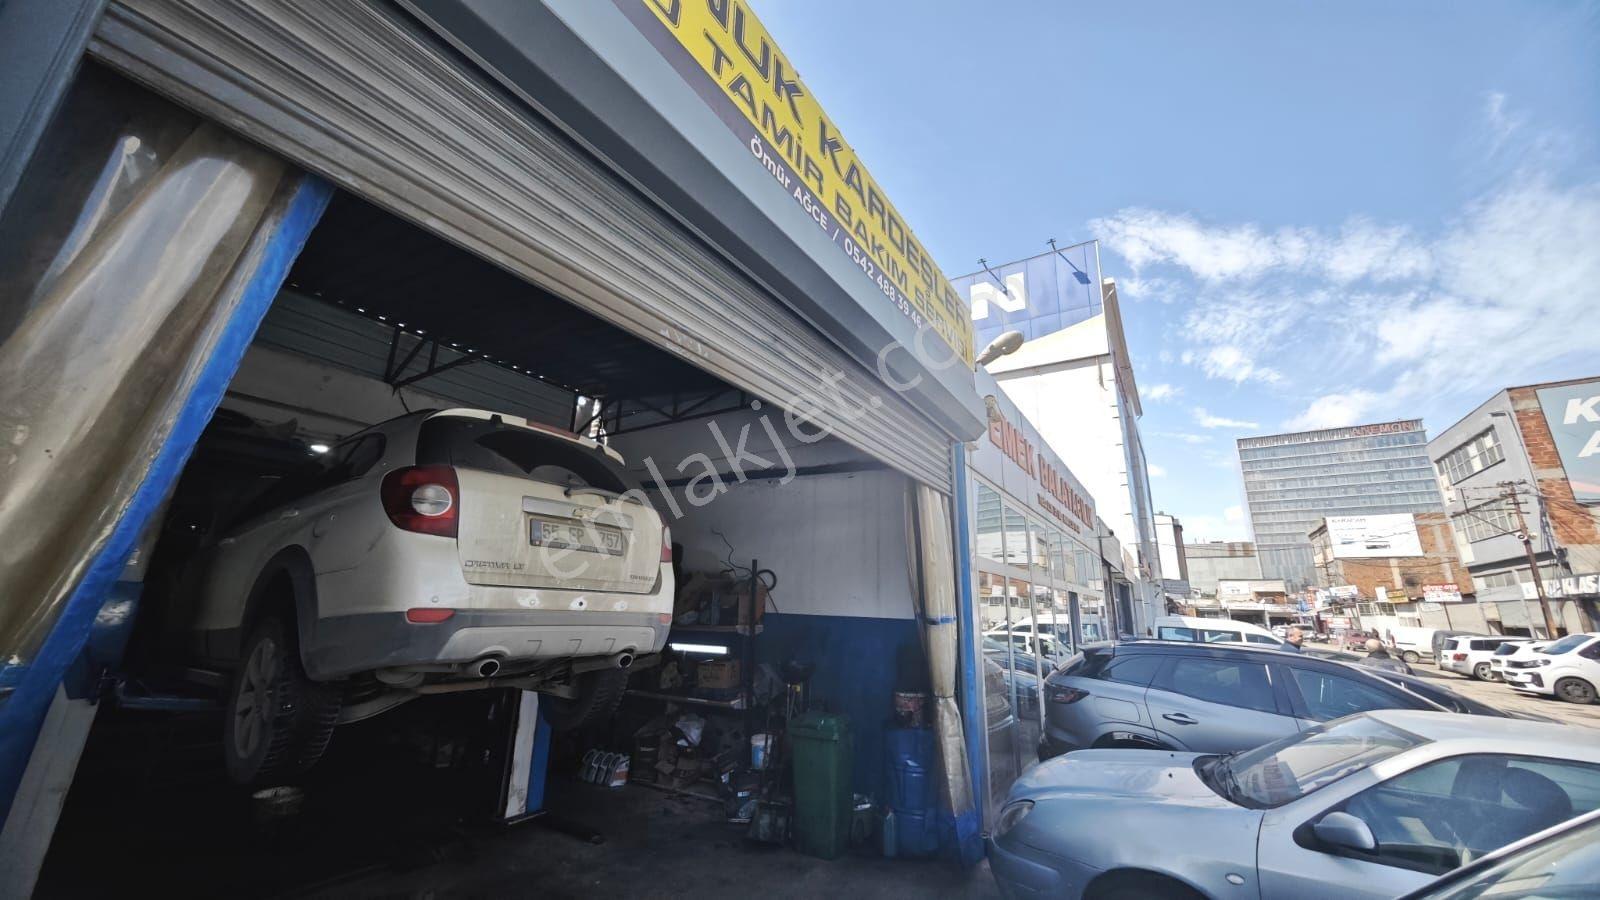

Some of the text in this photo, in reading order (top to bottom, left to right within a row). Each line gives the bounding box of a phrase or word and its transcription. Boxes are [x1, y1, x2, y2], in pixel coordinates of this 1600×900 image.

[749, 133, 791, 188] Ömür
[793, 187, 828, 231] AĞCE
[844, 238, 875, 280] 0542
[876, 276, 896, 302] 488
[897, 298, 910, 315] 39
[911, 311, 922, 329] 46
[834, 191, 909, 293] BAKIM
